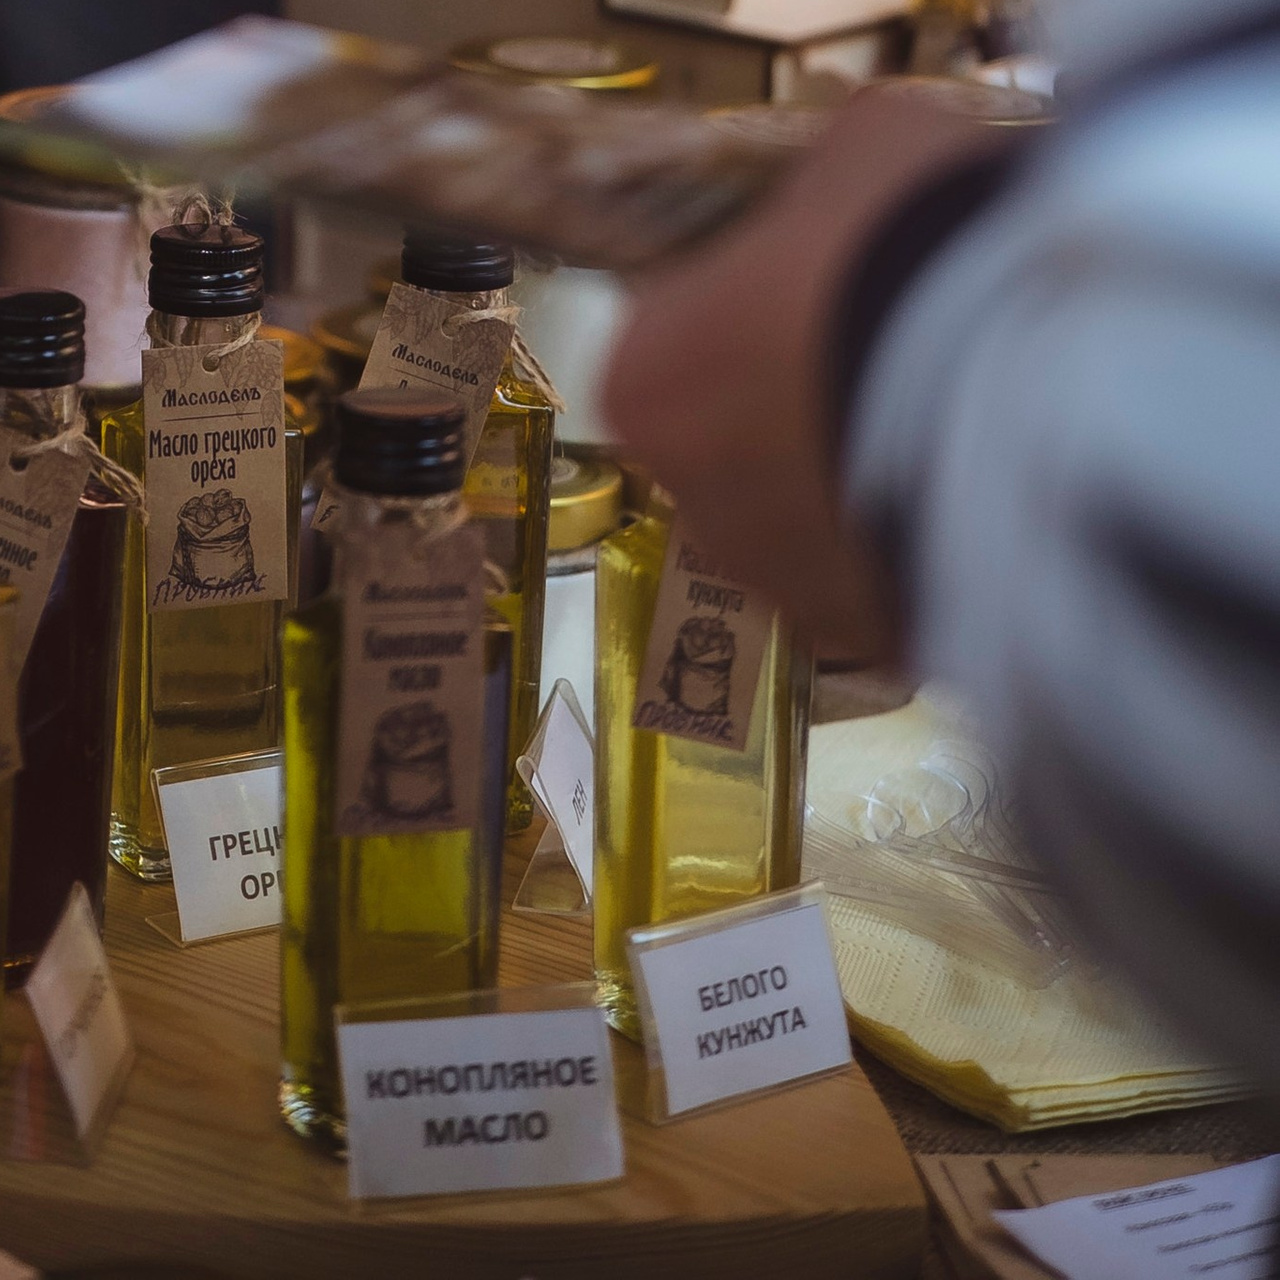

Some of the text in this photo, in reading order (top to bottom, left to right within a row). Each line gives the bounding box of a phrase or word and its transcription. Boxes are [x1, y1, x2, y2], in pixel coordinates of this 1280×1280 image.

[149, 426, 277, 460] Масло грецкого
[191, 457, 236, 488] ореха
[696, 964, 790, 1013] БЕЛОГО
[695, 1005, 808, 1061] КУНЖУТА
[365, 1055, 600, 1102] КОНОПЛЯНОЕ
[422, 1110, 551, 1149] МАСЛО
